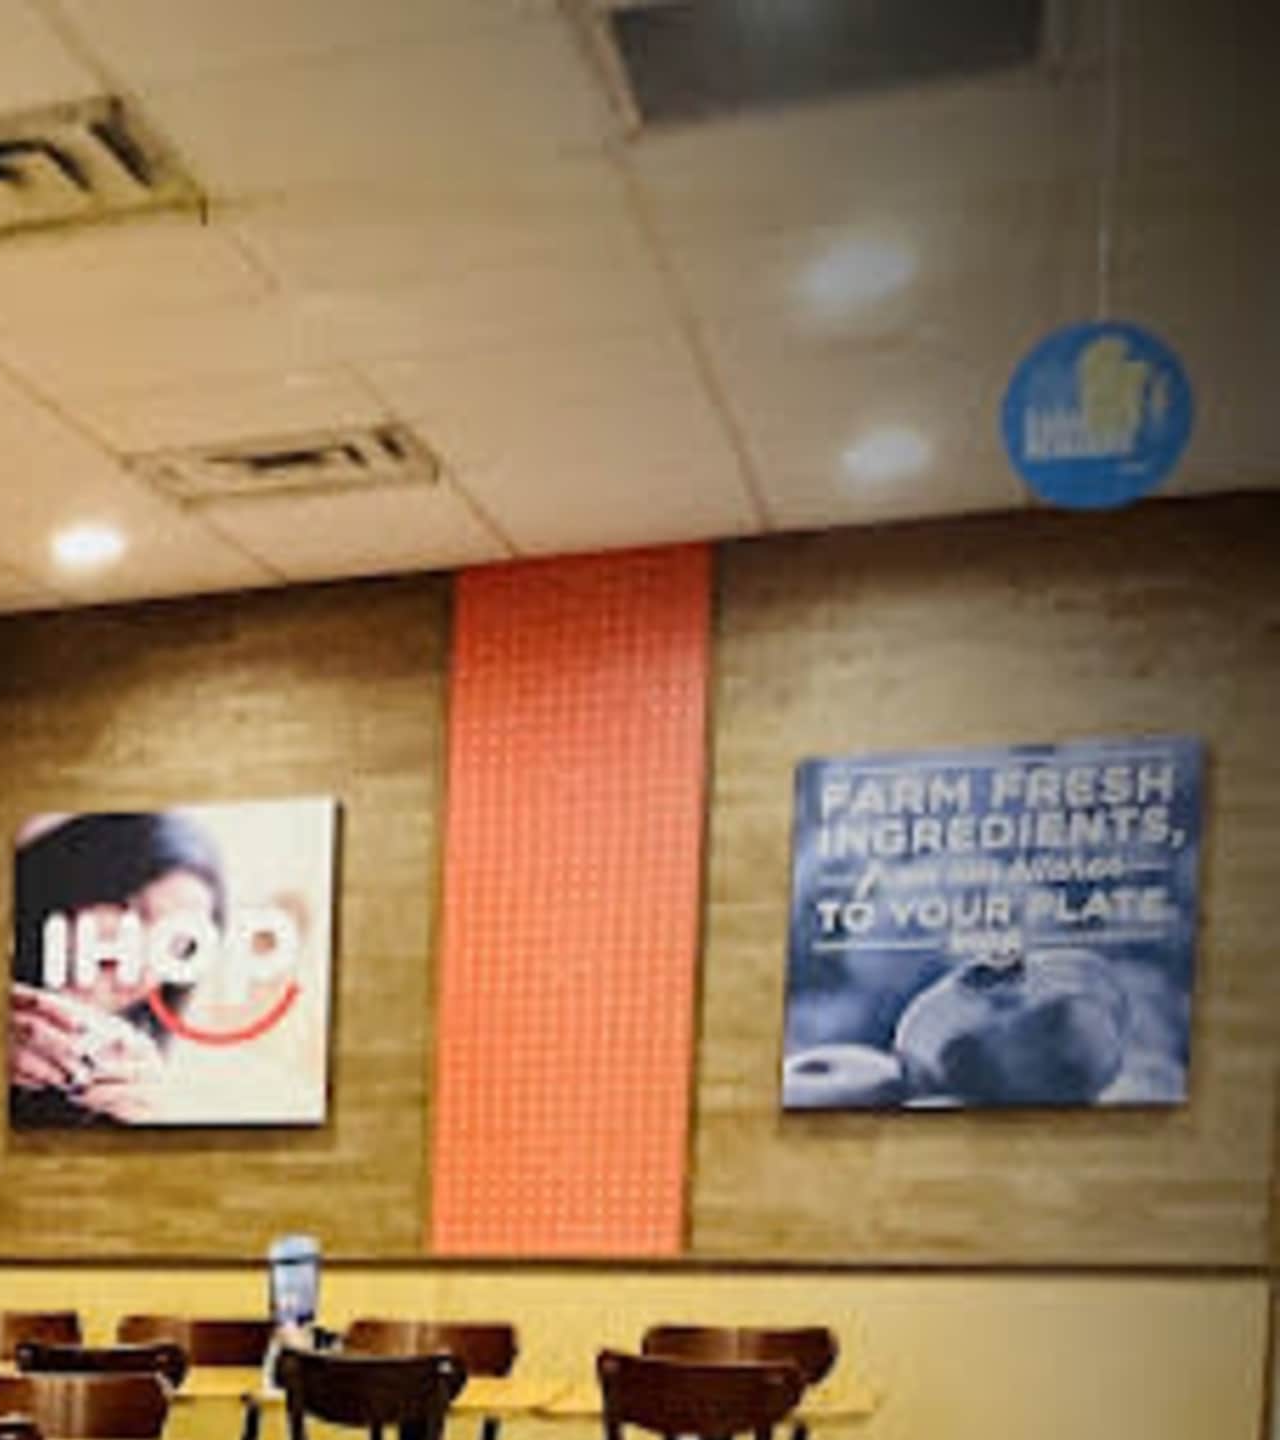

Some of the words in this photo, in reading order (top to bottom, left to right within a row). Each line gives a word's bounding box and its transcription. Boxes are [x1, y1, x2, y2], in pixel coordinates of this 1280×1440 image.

[821, 768, 972, 818] FARM
[992, 763, 1174, 809] FRESH
[818, 806, 1186, 858] INGREDIENTS,
[816, 901, 876, 933] TO
[890, 893, 1011, 928] YOUR
